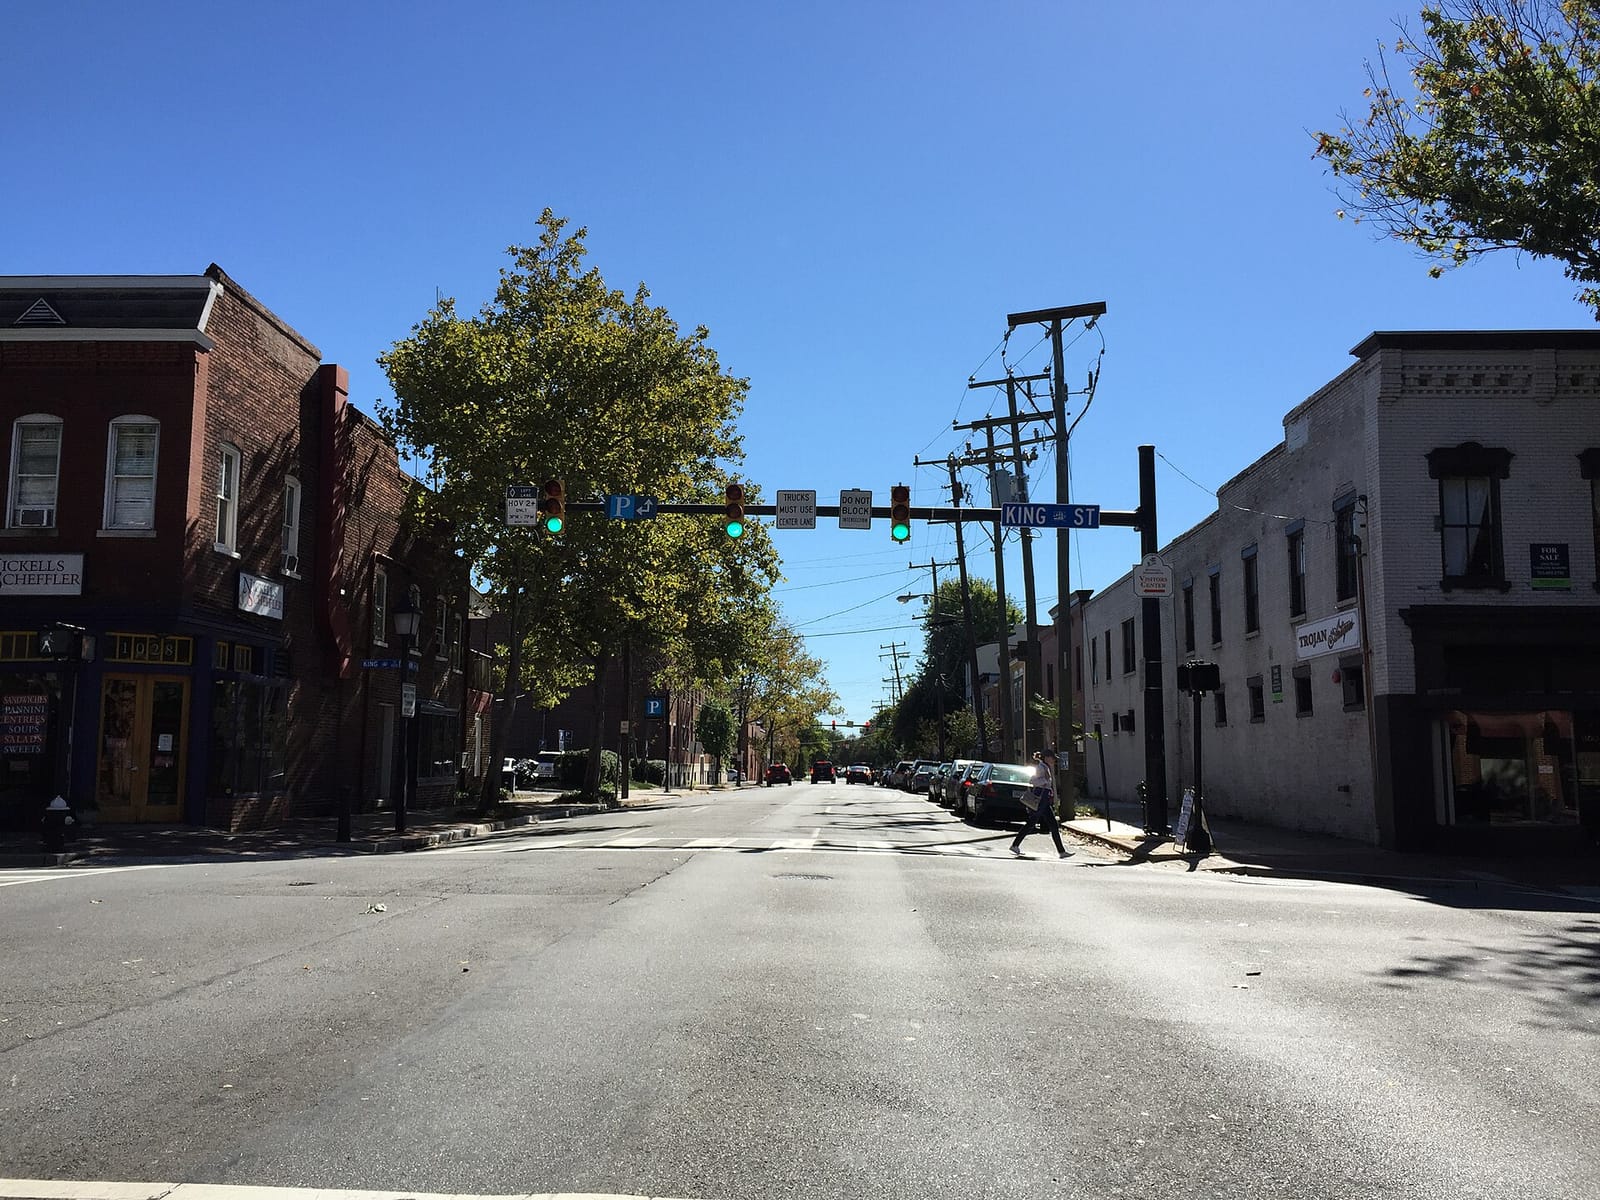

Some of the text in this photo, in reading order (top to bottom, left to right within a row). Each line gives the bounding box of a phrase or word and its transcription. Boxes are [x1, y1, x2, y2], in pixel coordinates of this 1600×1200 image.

[784, 493, 810, 502] TRUCKS
[842, 496, 870, 505] DO NOT
[613, 496, 631, 517] P
[779, 505, 814, 514] MUST USE
[842, 507, 869, 515] BLOCK
[1006, 506, 1095, 526] KING ST
[779, 517, 814, 526] CENTER LANE
[0, 559, 65, 572] ICKELLS
[0, 572, 80, 588] CHEFFLER
[1299, 629, 1327, 648] TROJAN
[121, 641, 174, 657] 1028
[3, 695, 48, 704] SANDWICHES
[5, 705, 46, 714] PANNINI
[649, 700, 660, 714] P
[8, 725, 40, 734] SOUPS
[4, 735, 42, 744] SALADS
[3, 744, 41, 753] SWEETS
